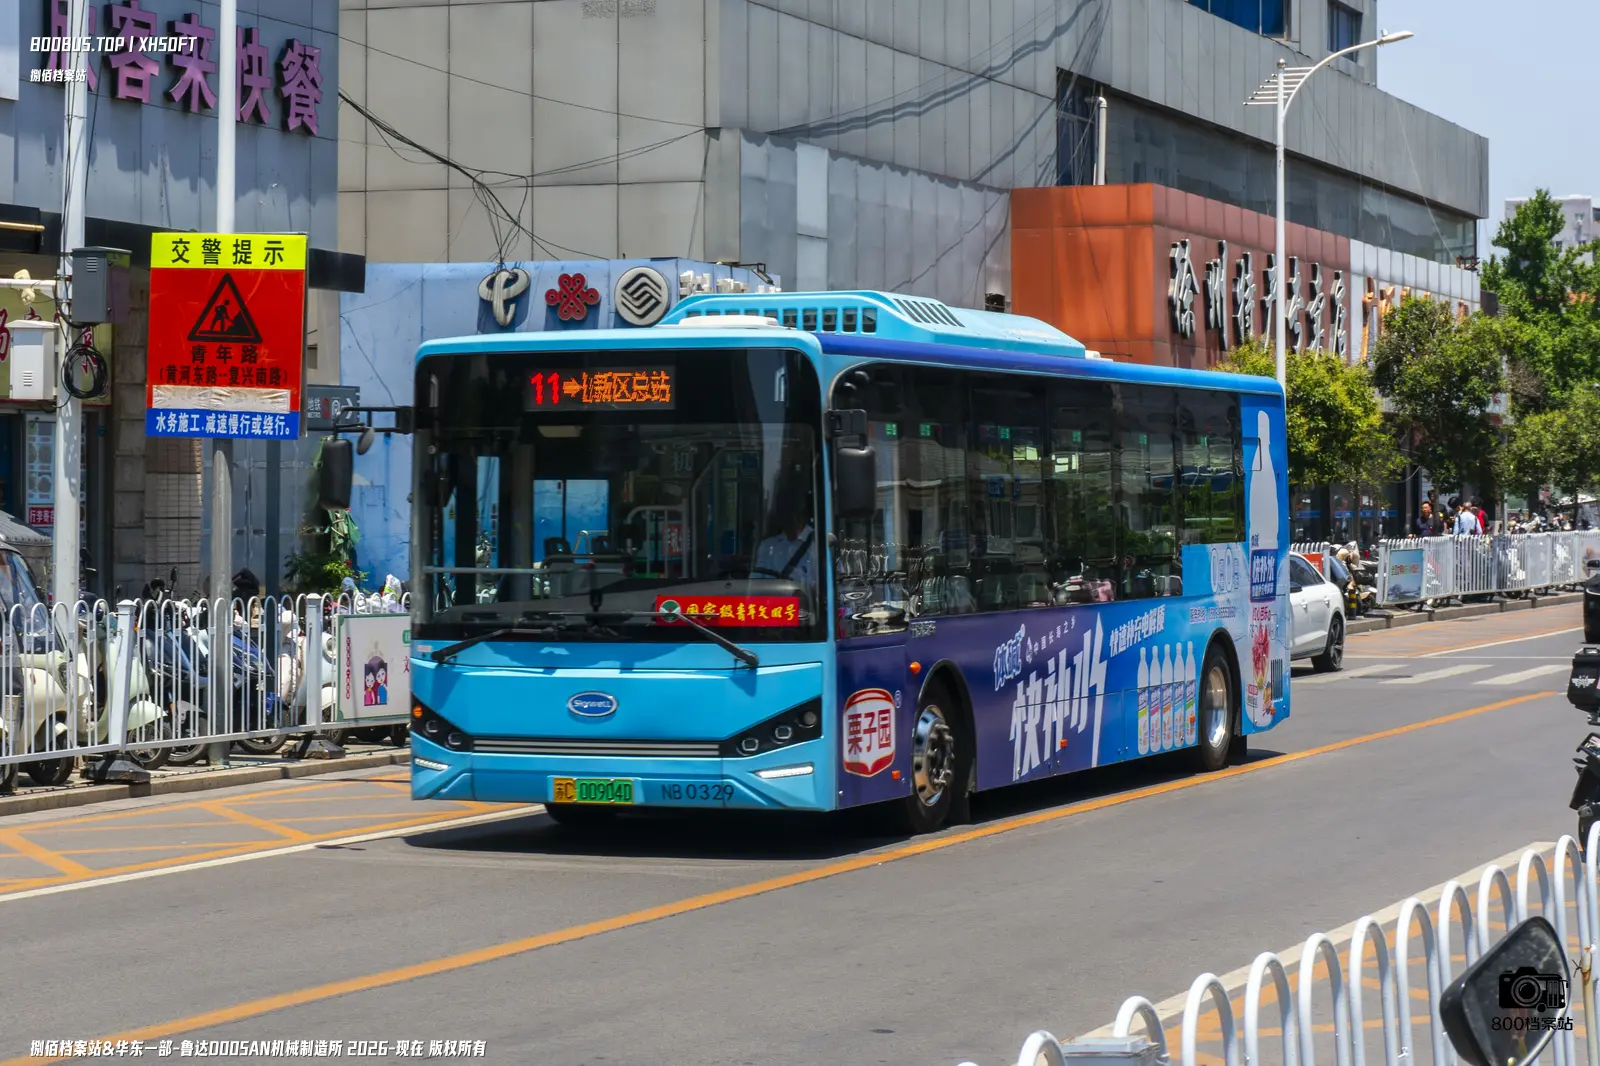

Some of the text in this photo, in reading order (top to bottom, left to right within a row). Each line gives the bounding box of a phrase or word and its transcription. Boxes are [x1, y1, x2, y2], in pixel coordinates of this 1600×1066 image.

[171, 239, 284, 265] 交警提示
[191, 345, 258, 364] 青年路
[530, 372, 560, 404] 11
[686, 602, 796, 621] 国家级青年文明号
[1009, 611, 1108, 782] 快补水
[847, 708, 892, 755] 栗子园
